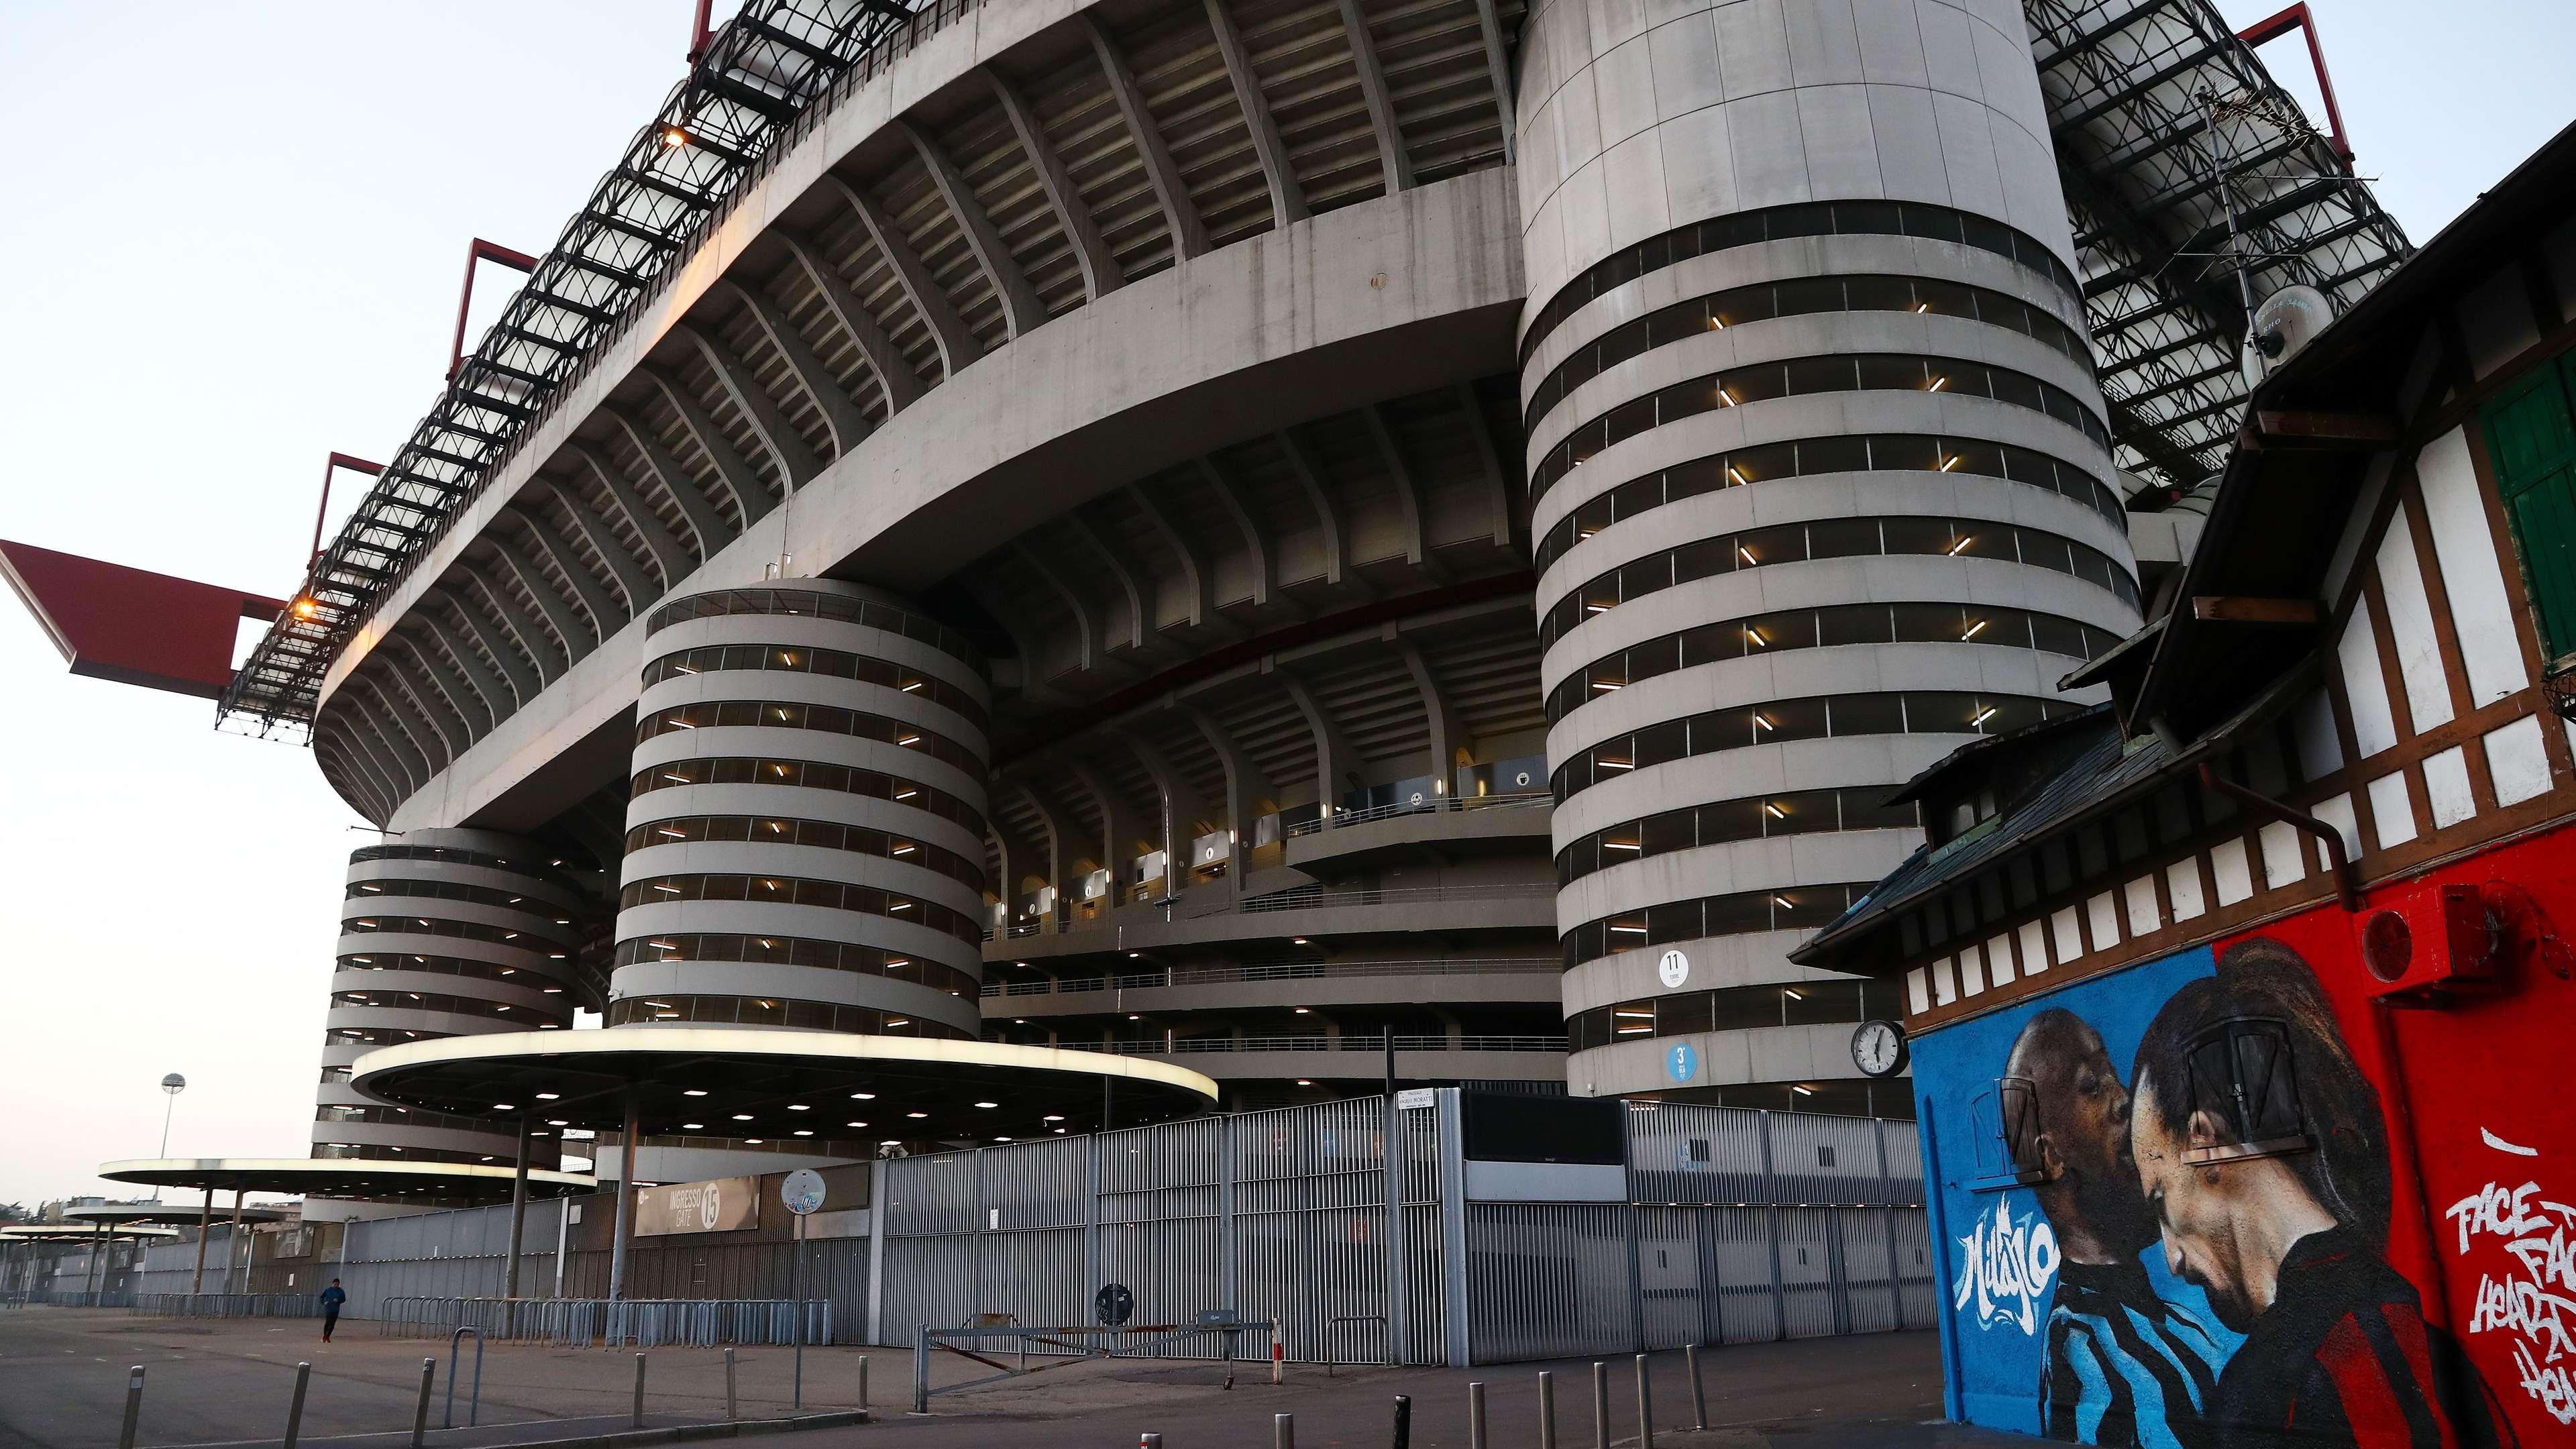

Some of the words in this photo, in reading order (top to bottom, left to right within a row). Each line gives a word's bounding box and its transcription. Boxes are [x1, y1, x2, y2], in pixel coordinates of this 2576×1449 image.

[2263, 318, 2281, 333] RHO
[1667, 953, 1678, 971] 11
[669, 1188, 701, 1210] INGRESSO
[704, 1189, 717, 1224] 15
[676, 1209, 692, 1227] GATE
[2446, 1181, 2555, 1256] FACE
